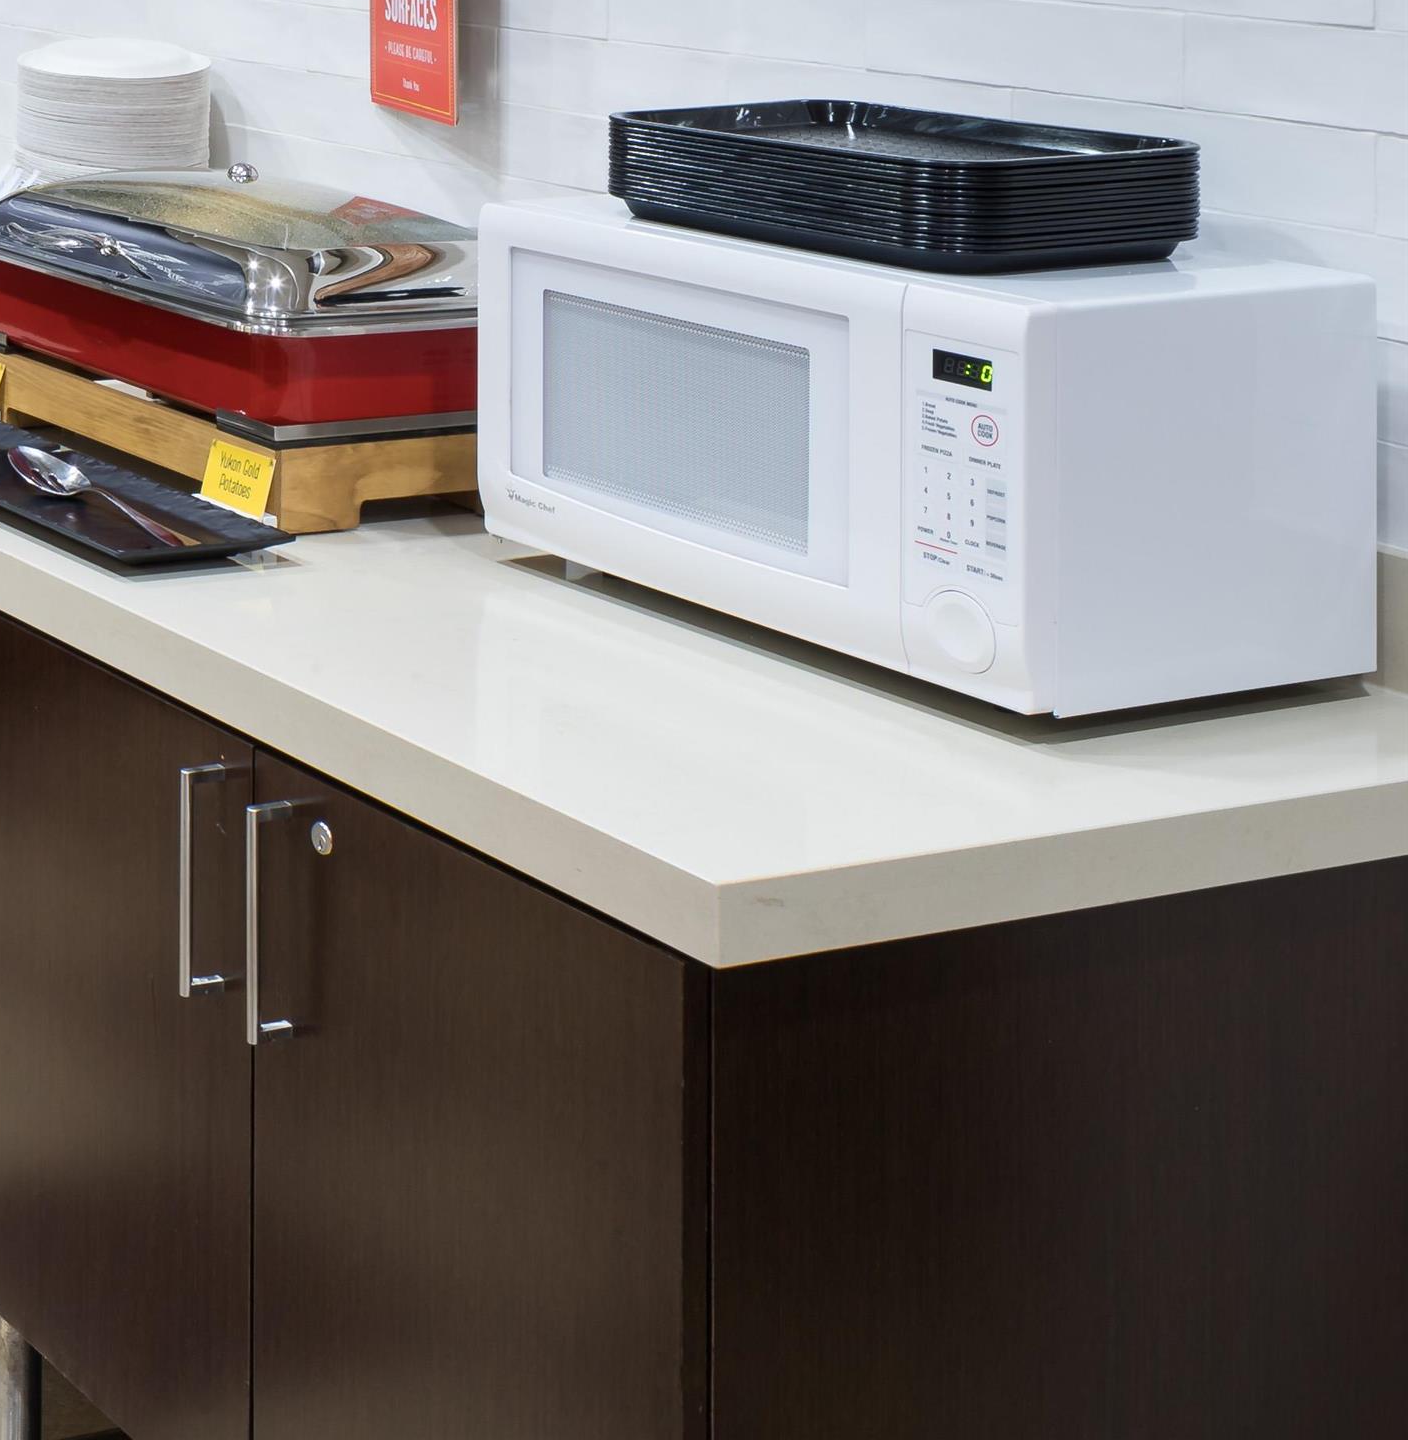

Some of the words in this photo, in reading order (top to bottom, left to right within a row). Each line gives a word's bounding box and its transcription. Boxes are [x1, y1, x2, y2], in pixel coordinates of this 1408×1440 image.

[388, 41, 404, 57] PLEASE
[978, 423, 993, 432] AUTO
[978, 430, 993, 439] COOK
[220, 451, 241, 473] Yukon
[243, 459, 261, 479] Gold
[947, 472, 951, 480] 2
[219, 474, 251, 499] Potatoes
[970, 478, 975, 487] 3
[947, 492, 951, 500] 5
[970, 499, 974, 507] 6
[971, 519, 974, 527] 9
[917, 526, 934, 534] POWER
[947, 531, 951, 539] 0
[965, 539, 979, 548] CLOCK
